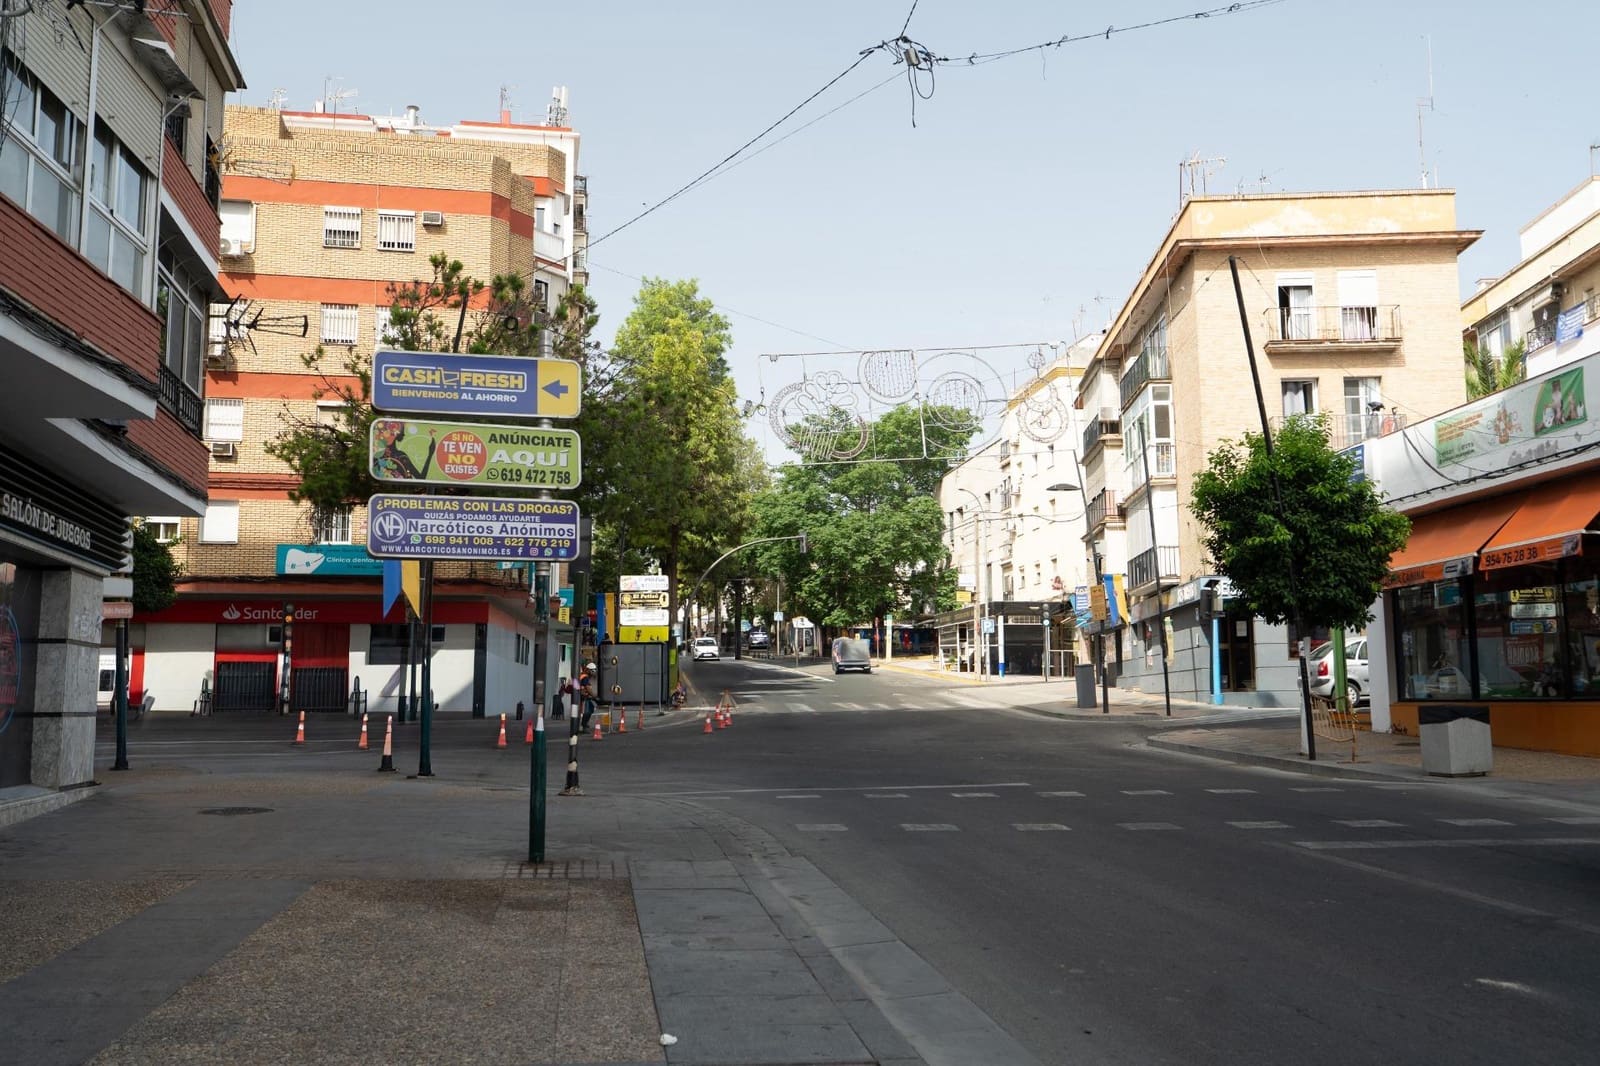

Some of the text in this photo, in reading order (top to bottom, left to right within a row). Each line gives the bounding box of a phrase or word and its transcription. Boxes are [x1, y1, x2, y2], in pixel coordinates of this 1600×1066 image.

[385, 367, 524, 389] CASH FRESH
[392, 389, 518, 403] BIENVENIDOS AL AHORRO
[452, 433, 474, 442] SI NO
[488, 432, 572, 448] ANÚNCIATE
[443, 441, 482, 454] TE VEN
[448, 454, 476, 465] NO
[490, 449, 569, 468] AQUÍ
[445, 464, 478, 475] EXISTES
[501, 468, 571, 485] 619 472 758
[376, 498, 573, 515] ¿PROBLEMAS CON LAS DROGAS?
[2, 493, 91, 550] SALÓN DE JUEGOS
[424, 512, 541, 523] QUIZÁS PODAMOS AYUDARTE
[407, 519, 574, 537] Narcóticos Anónimos
[425, 535, 446, 544] 698
[449, 536, 469, 545] 941
[473, 537, 494, 546] 008
[504, 537, 525, 546] 622
[528, 538, 548, 547] 776
[550, 539, 571, 548] 219
[381, 545, 511, 556] WWW.NARCOTICOSANONIMOS.ES
[1486, 553, 1500, 567] 954
[1502, 552, 1512, 564] 76
[1514, 550, 1524, 562] 28
[1526, 547, 1538, 560] 38
